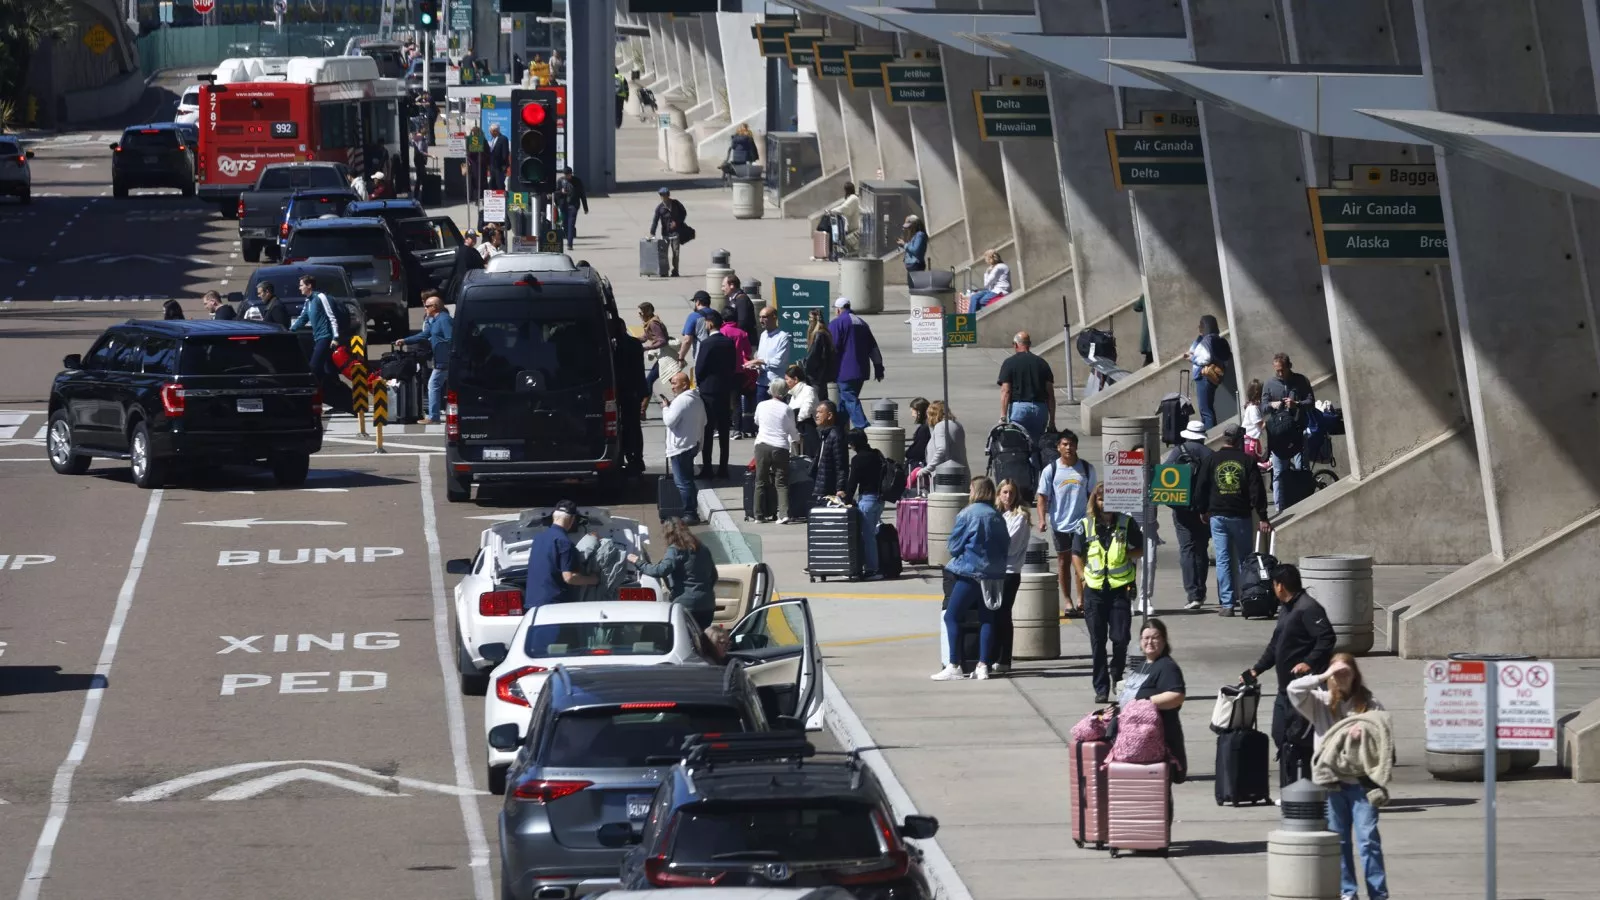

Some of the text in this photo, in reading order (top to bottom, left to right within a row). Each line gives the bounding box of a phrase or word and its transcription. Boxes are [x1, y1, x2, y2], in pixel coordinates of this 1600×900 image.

[903, 69, 931, 78] JetBlue
[899, 89, 925, 97] United
[996, 99, 1021, 109] Delta
[275, 123, 292, 133] 992
[995, 122, 1037, 131] Hawaiian
[1134, 140, 1194, 151] Air Canada
[219, 159, 257, 171] MTS
[1131, 168, 1160, 178] Delta
[1389, 168, 1440, 186] Bagga
[513, 193, 522, 204] R
[1341, 202, 1417, 215] Air Canada
[1346, 236, 1390, 249] Alaska
[955, 315, 968, 332] P
[948, 333, 975, 343] ZONE
[1111, 468, 1136, 476] ACTIVE
[1160, 467, 1180, 488] O
[1152, 491, 1188, 503] ZONE
[216, 546, 404, 567] BUMP
[216, 631, 401, 655] XING
[1450, 663, 1462, 671] NO
[1450, 673, 1484, 681] PARKING
[219, 671, 389, 696] PED
[1440, 688, 1473, 697] ACTIVE
[1516, 688, 1533, 698] NO
[1429, 718, 1484, 728] NO WAITING
